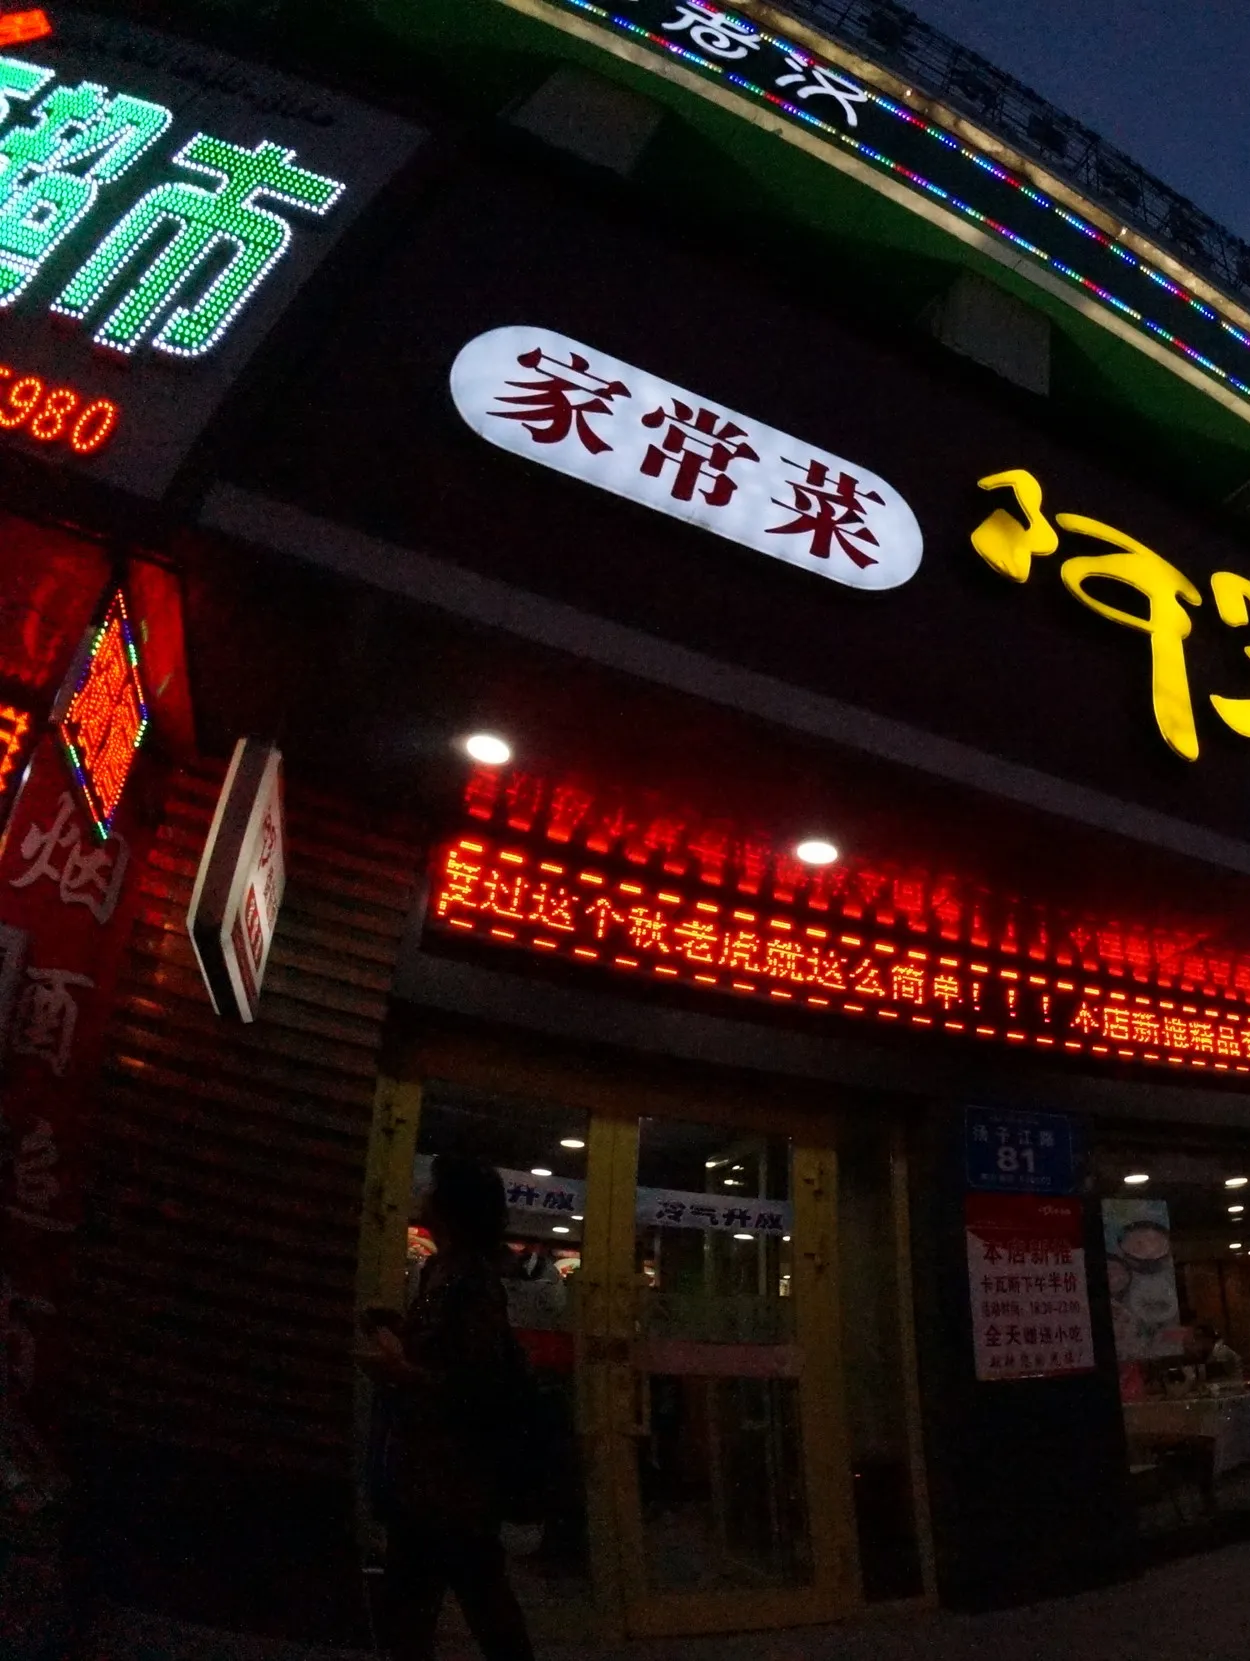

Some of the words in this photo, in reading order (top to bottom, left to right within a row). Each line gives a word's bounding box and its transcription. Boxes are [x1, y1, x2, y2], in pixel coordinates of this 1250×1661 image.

[486, 347, 886, 570] 家常菜
[995, 1145, 1037, 1174] 81
[656, 1199, 784, 1231] 冷气开放
[982, 1236, 1073, 1266] 本店新推
